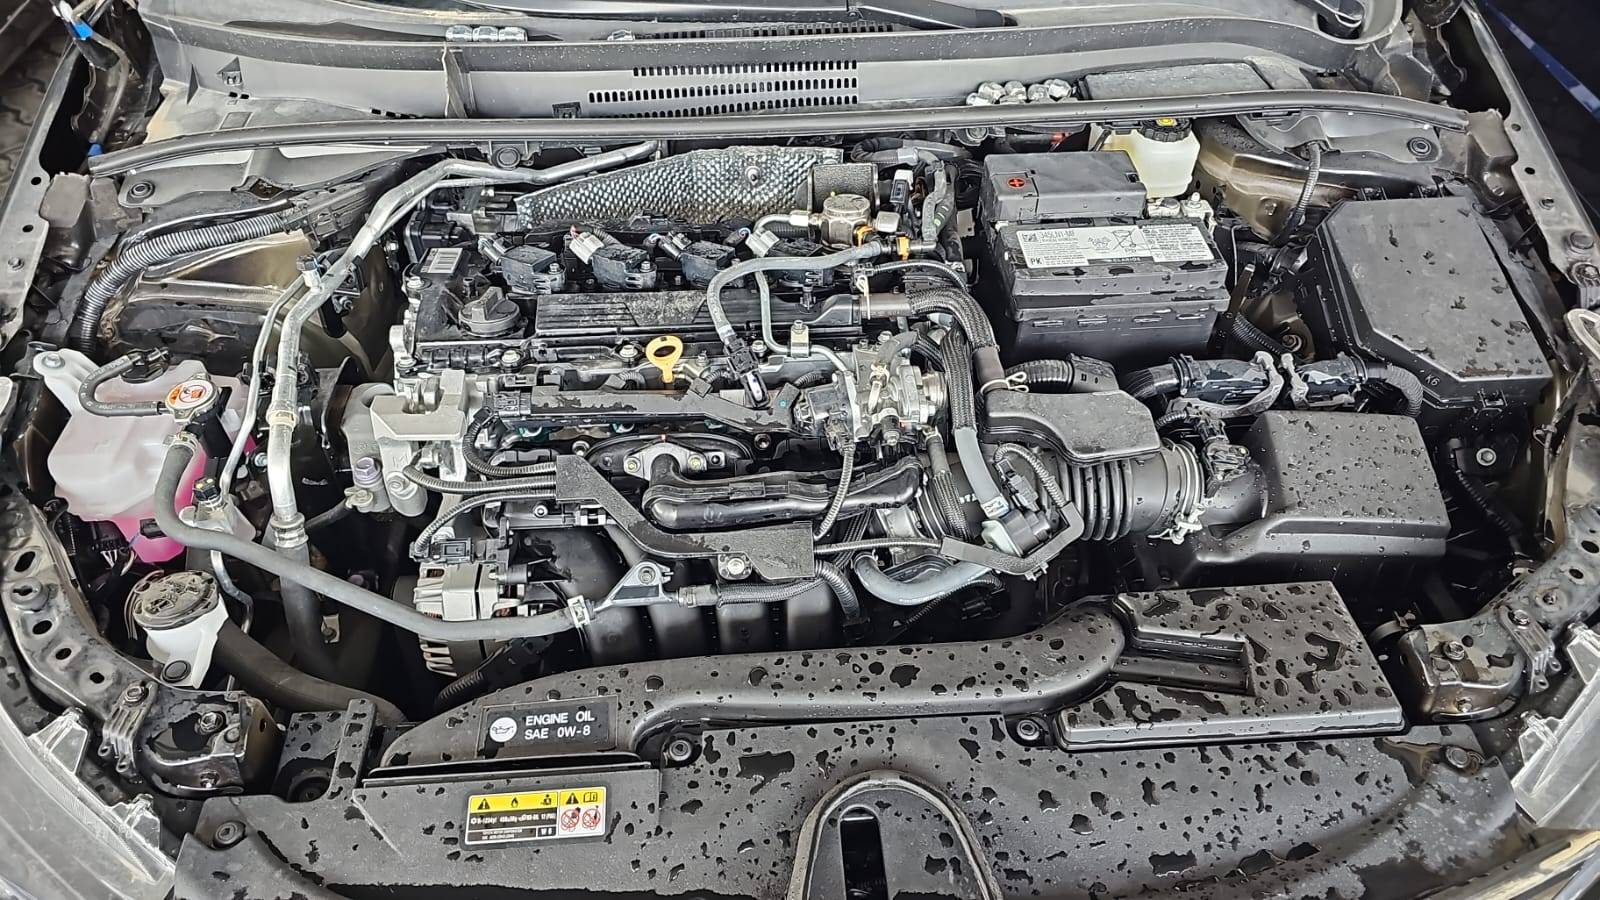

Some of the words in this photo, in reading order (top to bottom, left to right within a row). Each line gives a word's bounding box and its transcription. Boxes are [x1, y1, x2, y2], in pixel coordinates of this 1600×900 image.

[525, 712, 569, 726] ENGINE
[576, 710, 595, 723] OIL
[524, 727, 549, 740] SAE
[557, 725, 591, 738] 0W-8
